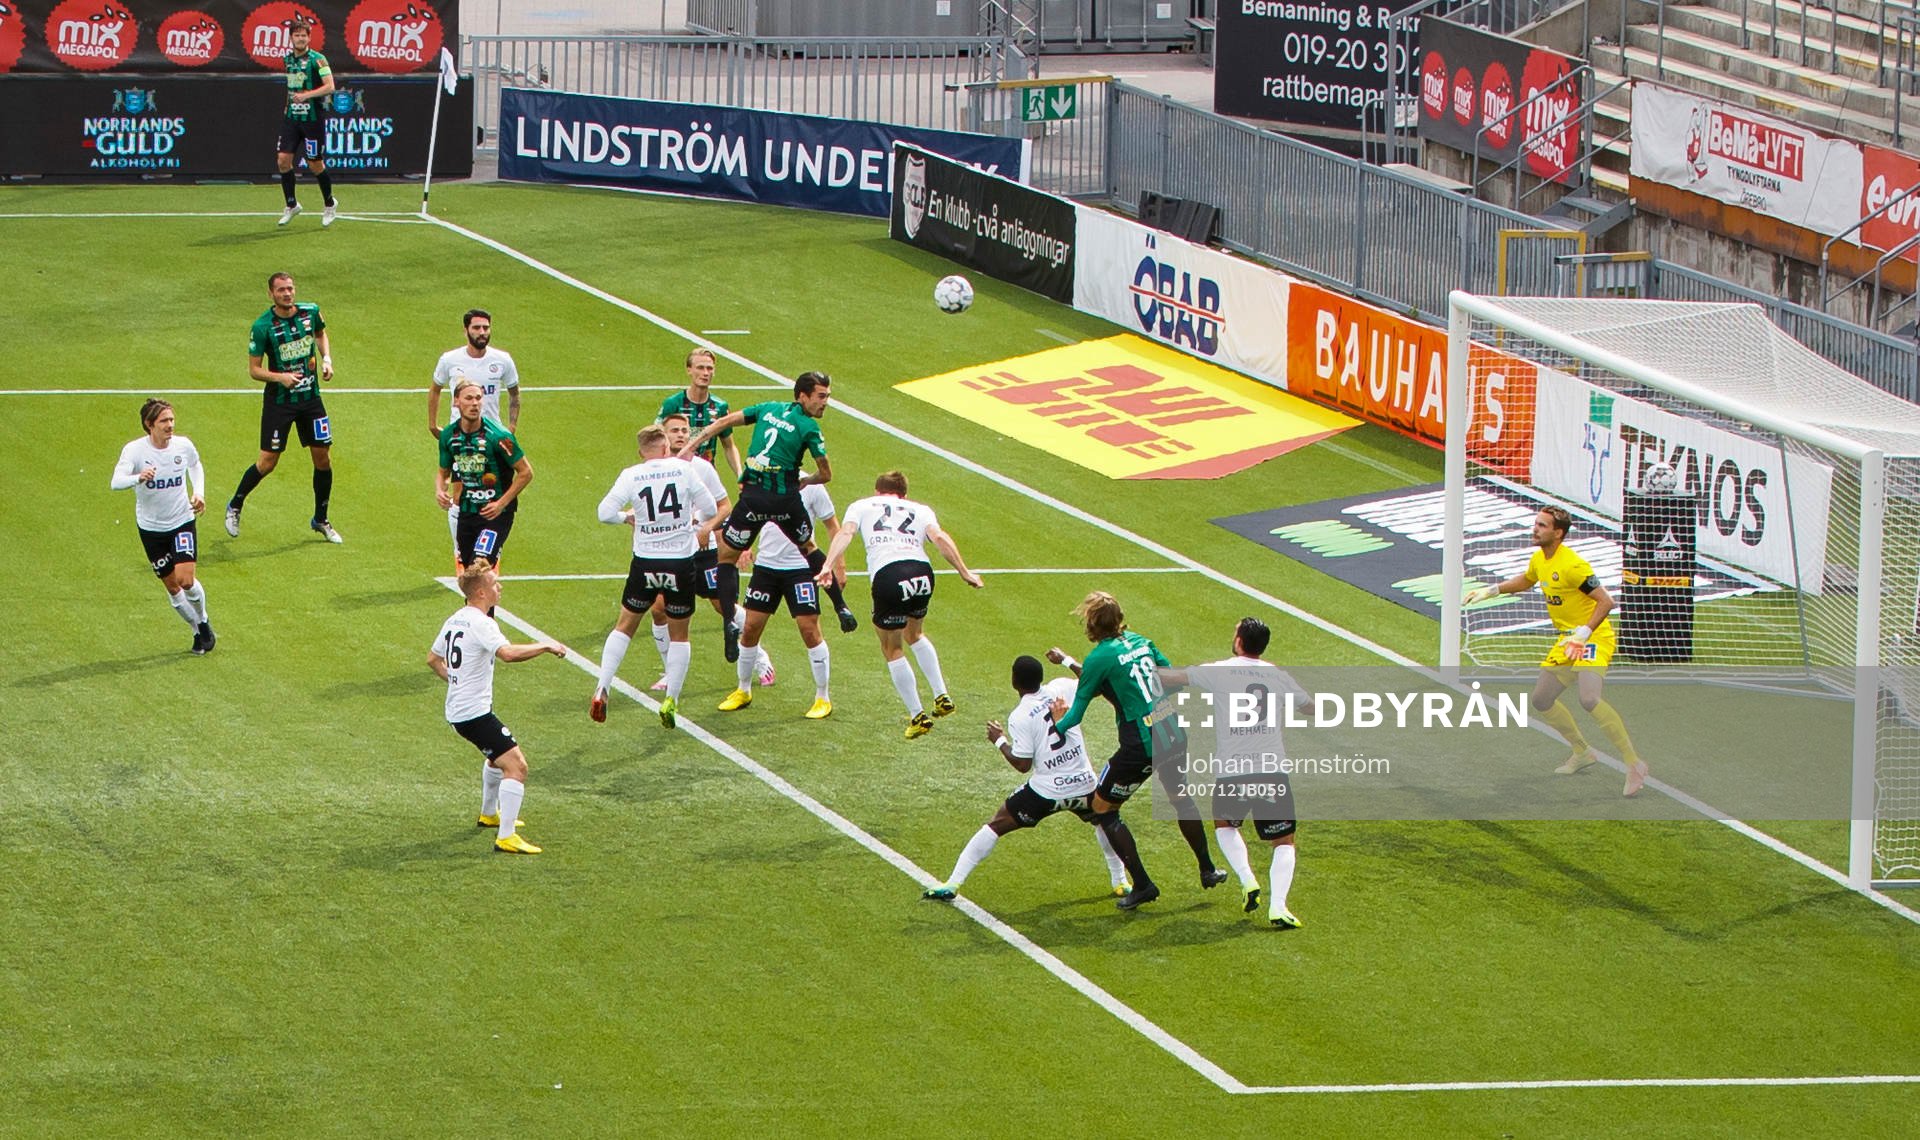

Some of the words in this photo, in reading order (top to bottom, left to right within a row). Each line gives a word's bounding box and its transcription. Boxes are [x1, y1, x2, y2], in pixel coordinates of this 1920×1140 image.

[1241, 0, 1351, 31] Bemanning
[1356, 4, 1372, 28] &
[58, 20, 124, 48] mix
[166, 29, 214, 50] mix
[253, 25, 294, 48] mi
[359, 20, 428, 49] mix
[57, 43, 120, 60] MEGAPOL
[165, 46, 210, 58] MEGAPOL
[358, 46, 423, 62] MEGAPOL
[1283, 32, 1368, 70] 019-20
[83, 117, 186, 136] NORRLANDS
[95, 131, 174, 155] GULD
[325, 131, 382, 154] ULD
[515, 115, 748, 178] LINDSTRÖM
[90, 157, 180, 169] ALKOHOLFRI
[298, 157, 388, 168] AOHOLFRI
[927, 189, 943, 219] En
[945, 193, 971, 232] klubb
[1000, 218, 1070, 269] anläggningar
[1132, 232, 1221, 357] ÖBAB
[1315, 308, 1506, 444] BAUHAS
[755, 427, 778, 466] 2
[1619, 422, 1767, 547] TEKNOS
[638, 483, 683, 522] 14
[871, 503, 916, 536] 22
[644, 572, 680, 592] NA
[897, 575, 932, 601] NA
[444, 630, 464, 669] 16
[1044, 745, 1083, 769] WRIGHT
